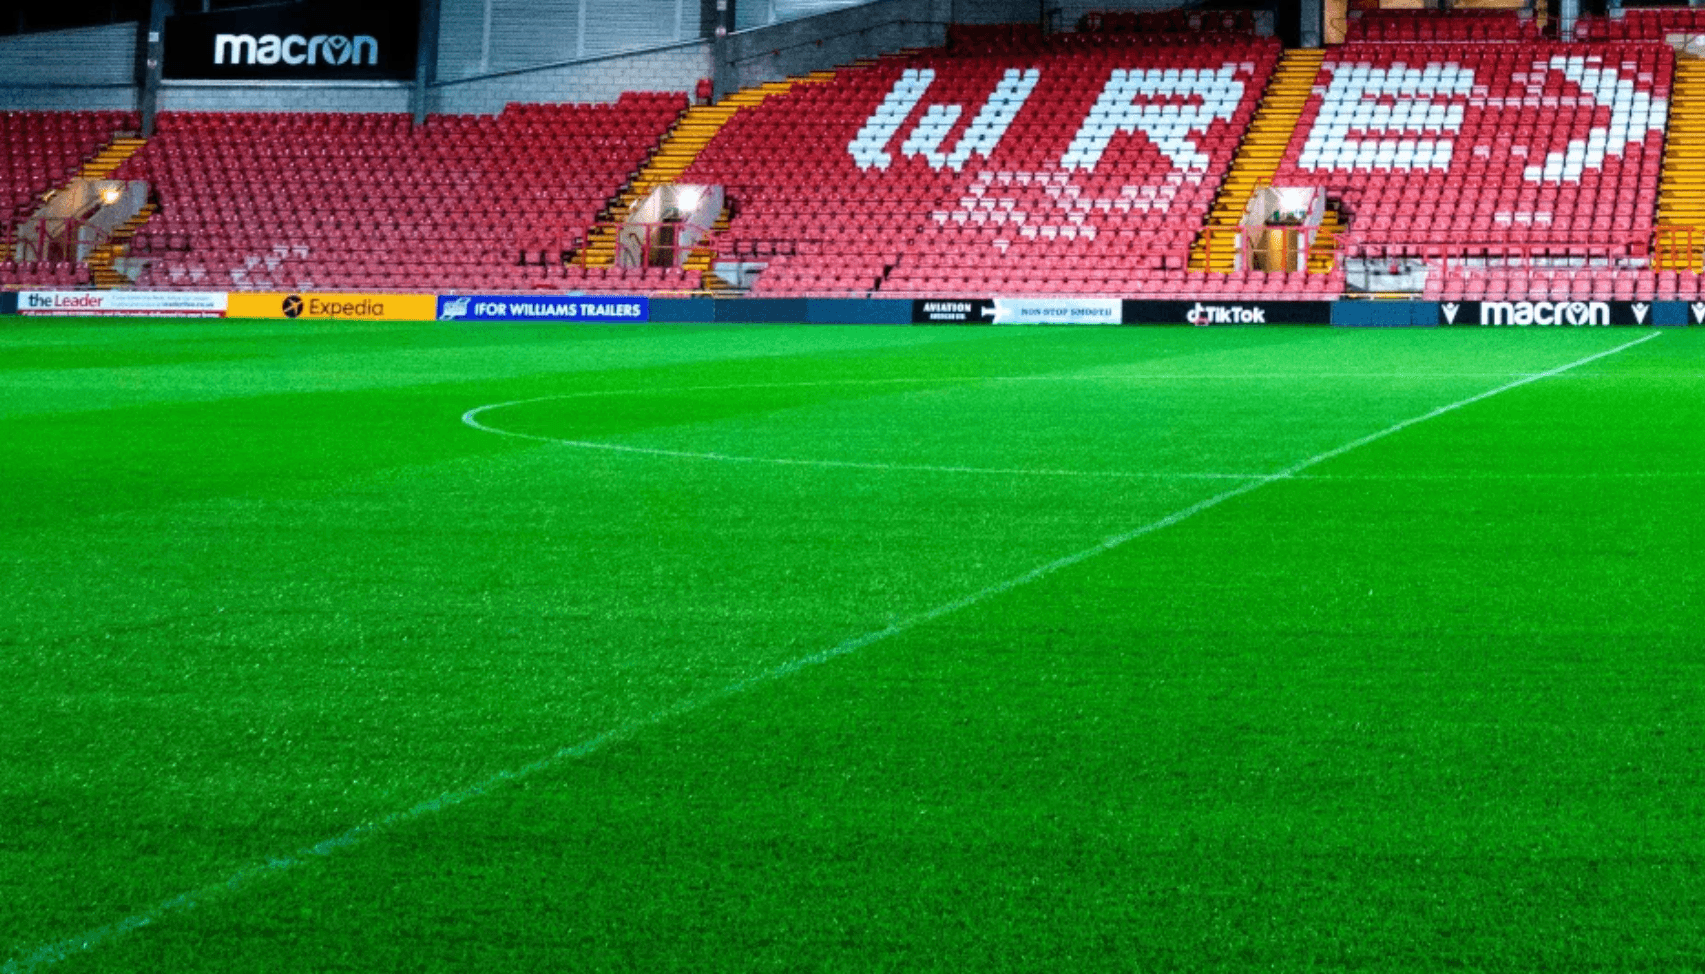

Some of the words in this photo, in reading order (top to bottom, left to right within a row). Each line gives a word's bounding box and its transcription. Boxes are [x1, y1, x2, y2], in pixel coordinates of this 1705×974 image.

[213, 33, 378, 65] macron
[28, 293, 51, 307] the
[54, 293, 104, 307] Leader
[309, 298, 384, 317] Expedia
[923, 302, 972, 312] AVIATION
[475, 302, 507, 317] IFOR
[509, 302, 577, 317] WILLIAMS
[579, 302, 641, 317] TRAILERS
[1206, 306, 1265, 323] TikTok
[1480, 300, 1610, 326] macron
